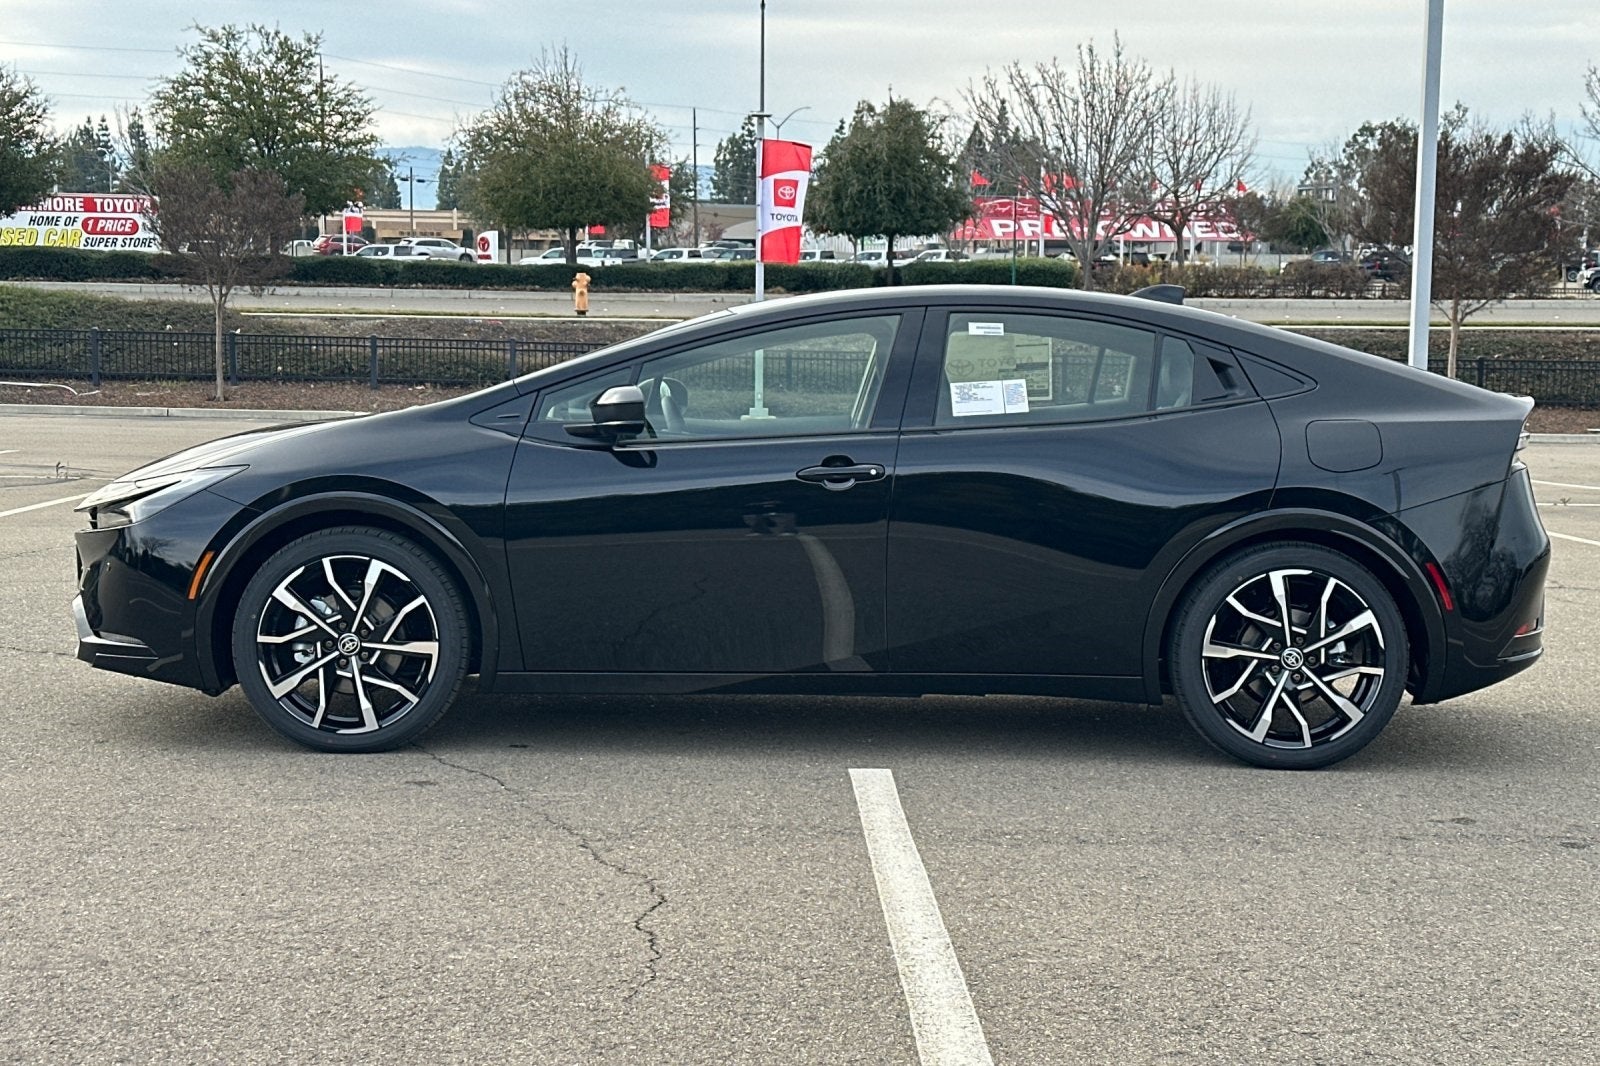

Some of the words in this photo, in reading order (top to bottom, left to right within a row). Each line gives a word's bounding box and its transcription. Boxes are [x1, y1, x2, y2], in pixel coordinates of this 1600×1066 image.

[28, 215, 61, 227] HOME
[64, 216, 79, 227] OF
[87, 218, 95, 232] 1
[96, 218, 134, 233] PRICE
[770, 213, 798, 222] TOYOTA
[44, 228, 82, 247] CAR
[83, 237, 118, 248] SUPER
[121, 238, 154, 248] STORE
